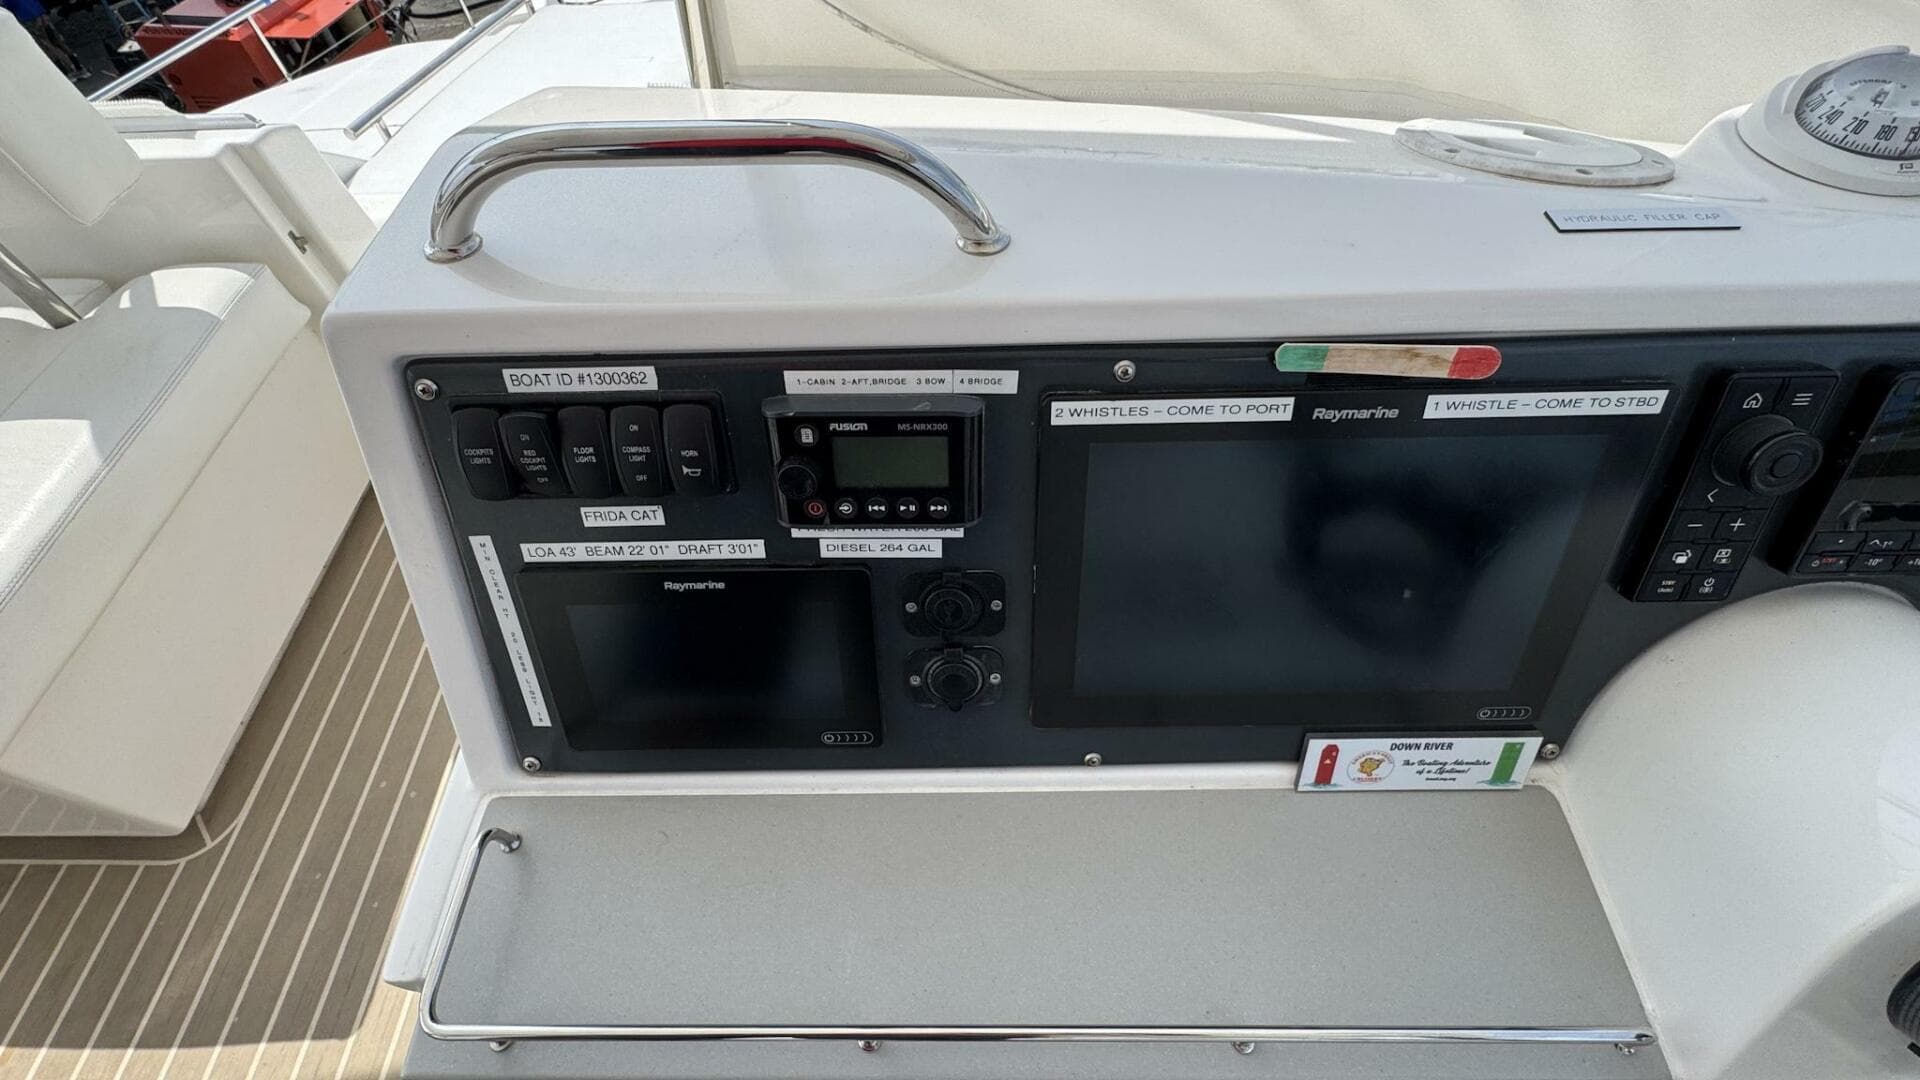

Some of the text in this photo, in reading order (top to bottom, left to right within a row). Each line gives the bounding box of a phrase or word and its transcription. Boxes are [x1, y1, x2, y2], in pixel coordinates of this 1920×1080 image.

[1818, 105, 1844, 125] 240
[1842, 117, 1869, 135] 210
[1873, 124, 1898, 141] 180
[1563, 213, 1721, 223] HYDRAULIC FILLER CAP
[509, 371, 648, 387] BOAT ID #1300362
[1433, 401, 1440, 411] 1
[1446, 400, 1517, 411] WHISTLE
[1535, 398, 1584, 410] COME
[1590, 397, 1611, 408] TO
[1614, 396, 1659, 408] STBD
[1055, 407, 1064, 418] 2
[1068, 406, 1149, 418] WHISTLES
[1167, 405, 1215, 417] COME
[1219, 404, 1241, 415] TO
[1246, 403, 1290, 415] PORT
[1312, 406, 1400, 421] Raymarine
[629, 424, 639, 432] ON
[897, 423, 949, 431] MS-NRX300
[464, 448, 494, 456] COCKPITS
[622, 446, 652, 454] COMPASS
[681, 450, 699, 458] HORN
[470, 457, 492, 465] LIGHTS
[575, 455, 597, 463] LIGHTS
[636, 474, 648, 482] OFF
[583, 509, 659, 522] FRIDA CAT
[528, 543, 759, 559] LOA 43' BEAM 22' 01" DRAFT 3'01"
[826, 544, 936, 553] DIESEL 264 GAL
[663, 580, 725, 592] Raymarine
[1390, 742, 1454, 751] DOWN RIVER
